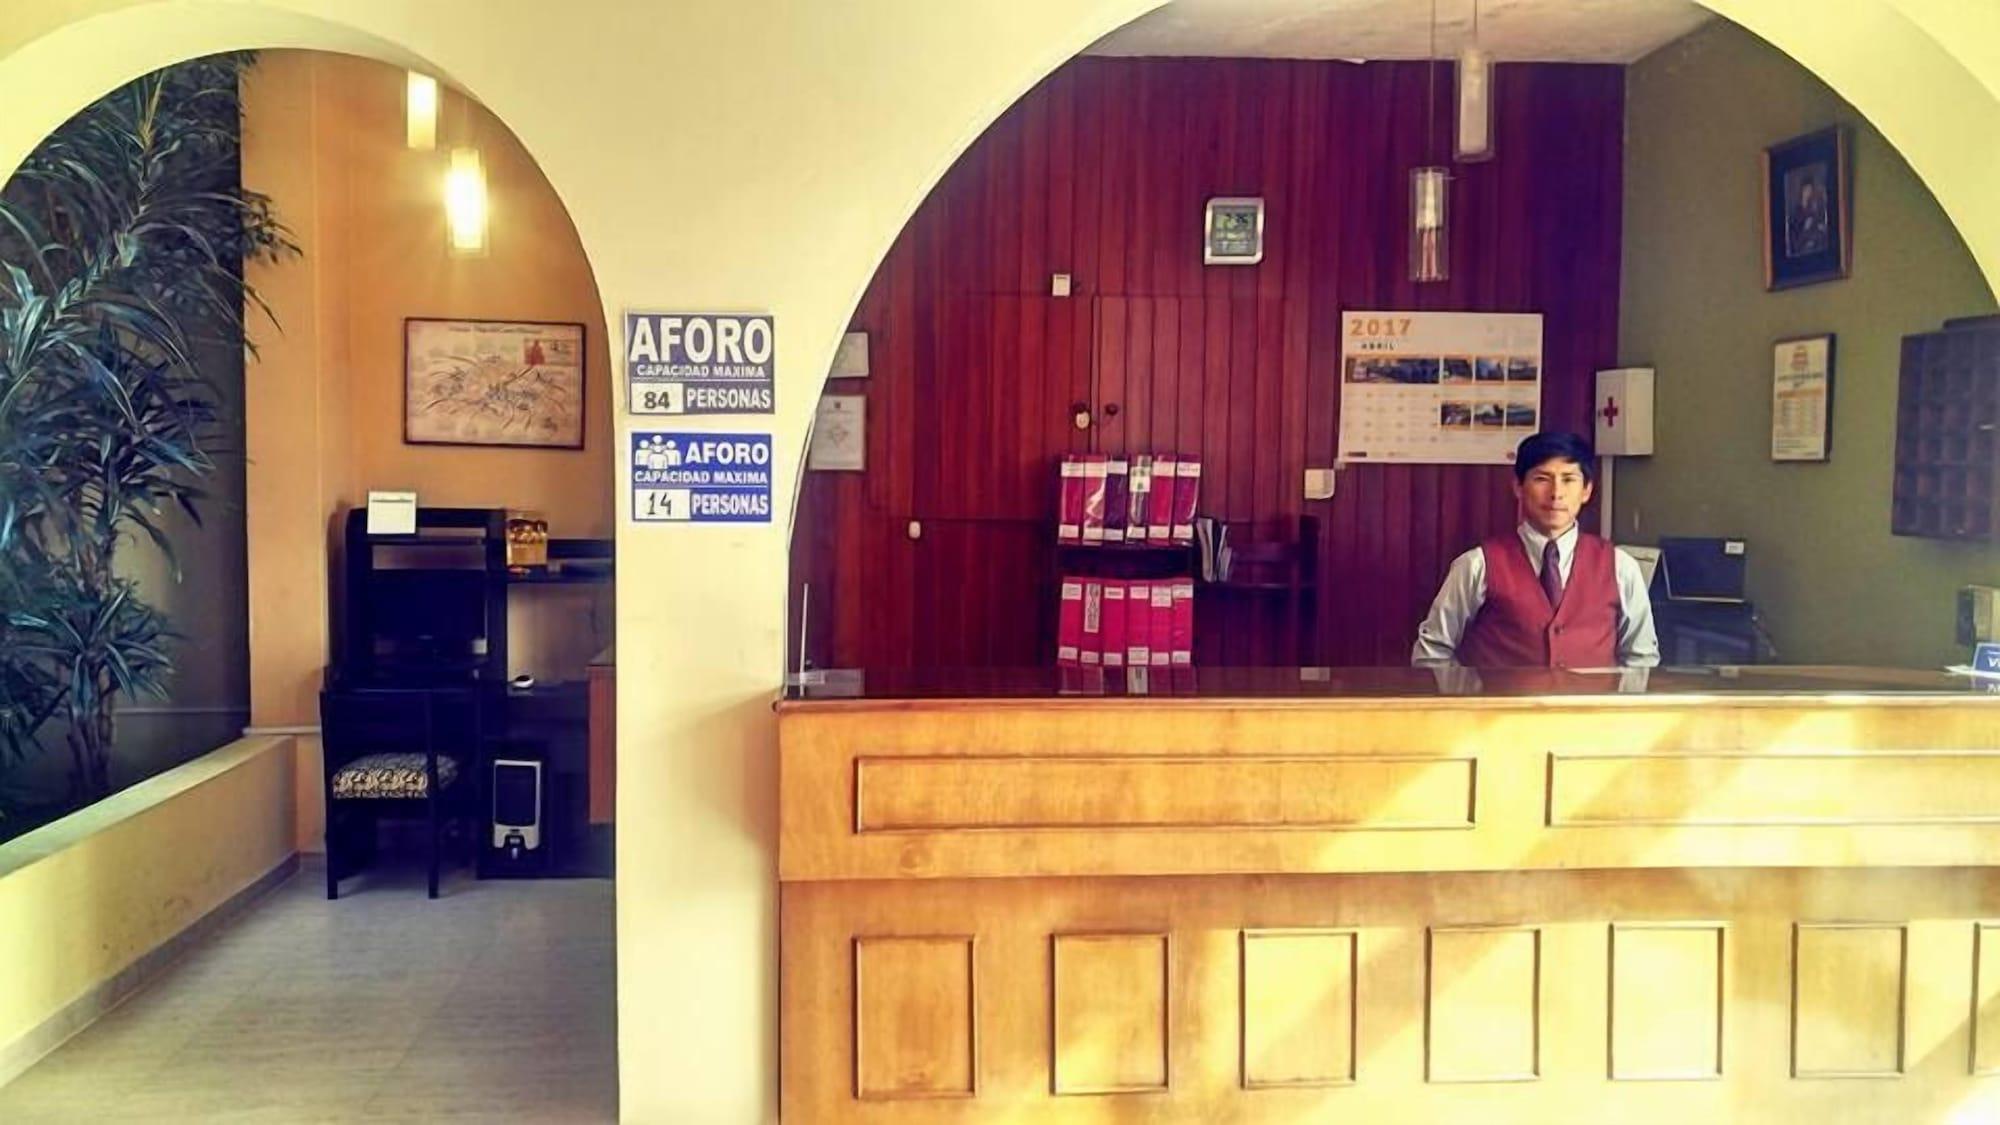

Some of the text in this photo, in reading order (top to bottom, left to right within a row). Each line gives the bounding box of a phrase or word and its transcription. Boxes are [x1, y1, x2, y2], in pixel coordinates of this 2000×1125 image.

[1351, 319, 1411, 336] 2017
[629, 317, 772, 363] AFORO
[1361, 342, 1395, 350] ABRIL
[637, 364, 766, 378] CAPACIDAD MAXIMA
[644, 388, 772, 409] 84 PERSONAS
[685, 441, 769, 465] AFORO
[634, 471, 768, 484] CAPACIDAD MAXIMA
[648, 492, 769, 516] 14 PERSONAS
